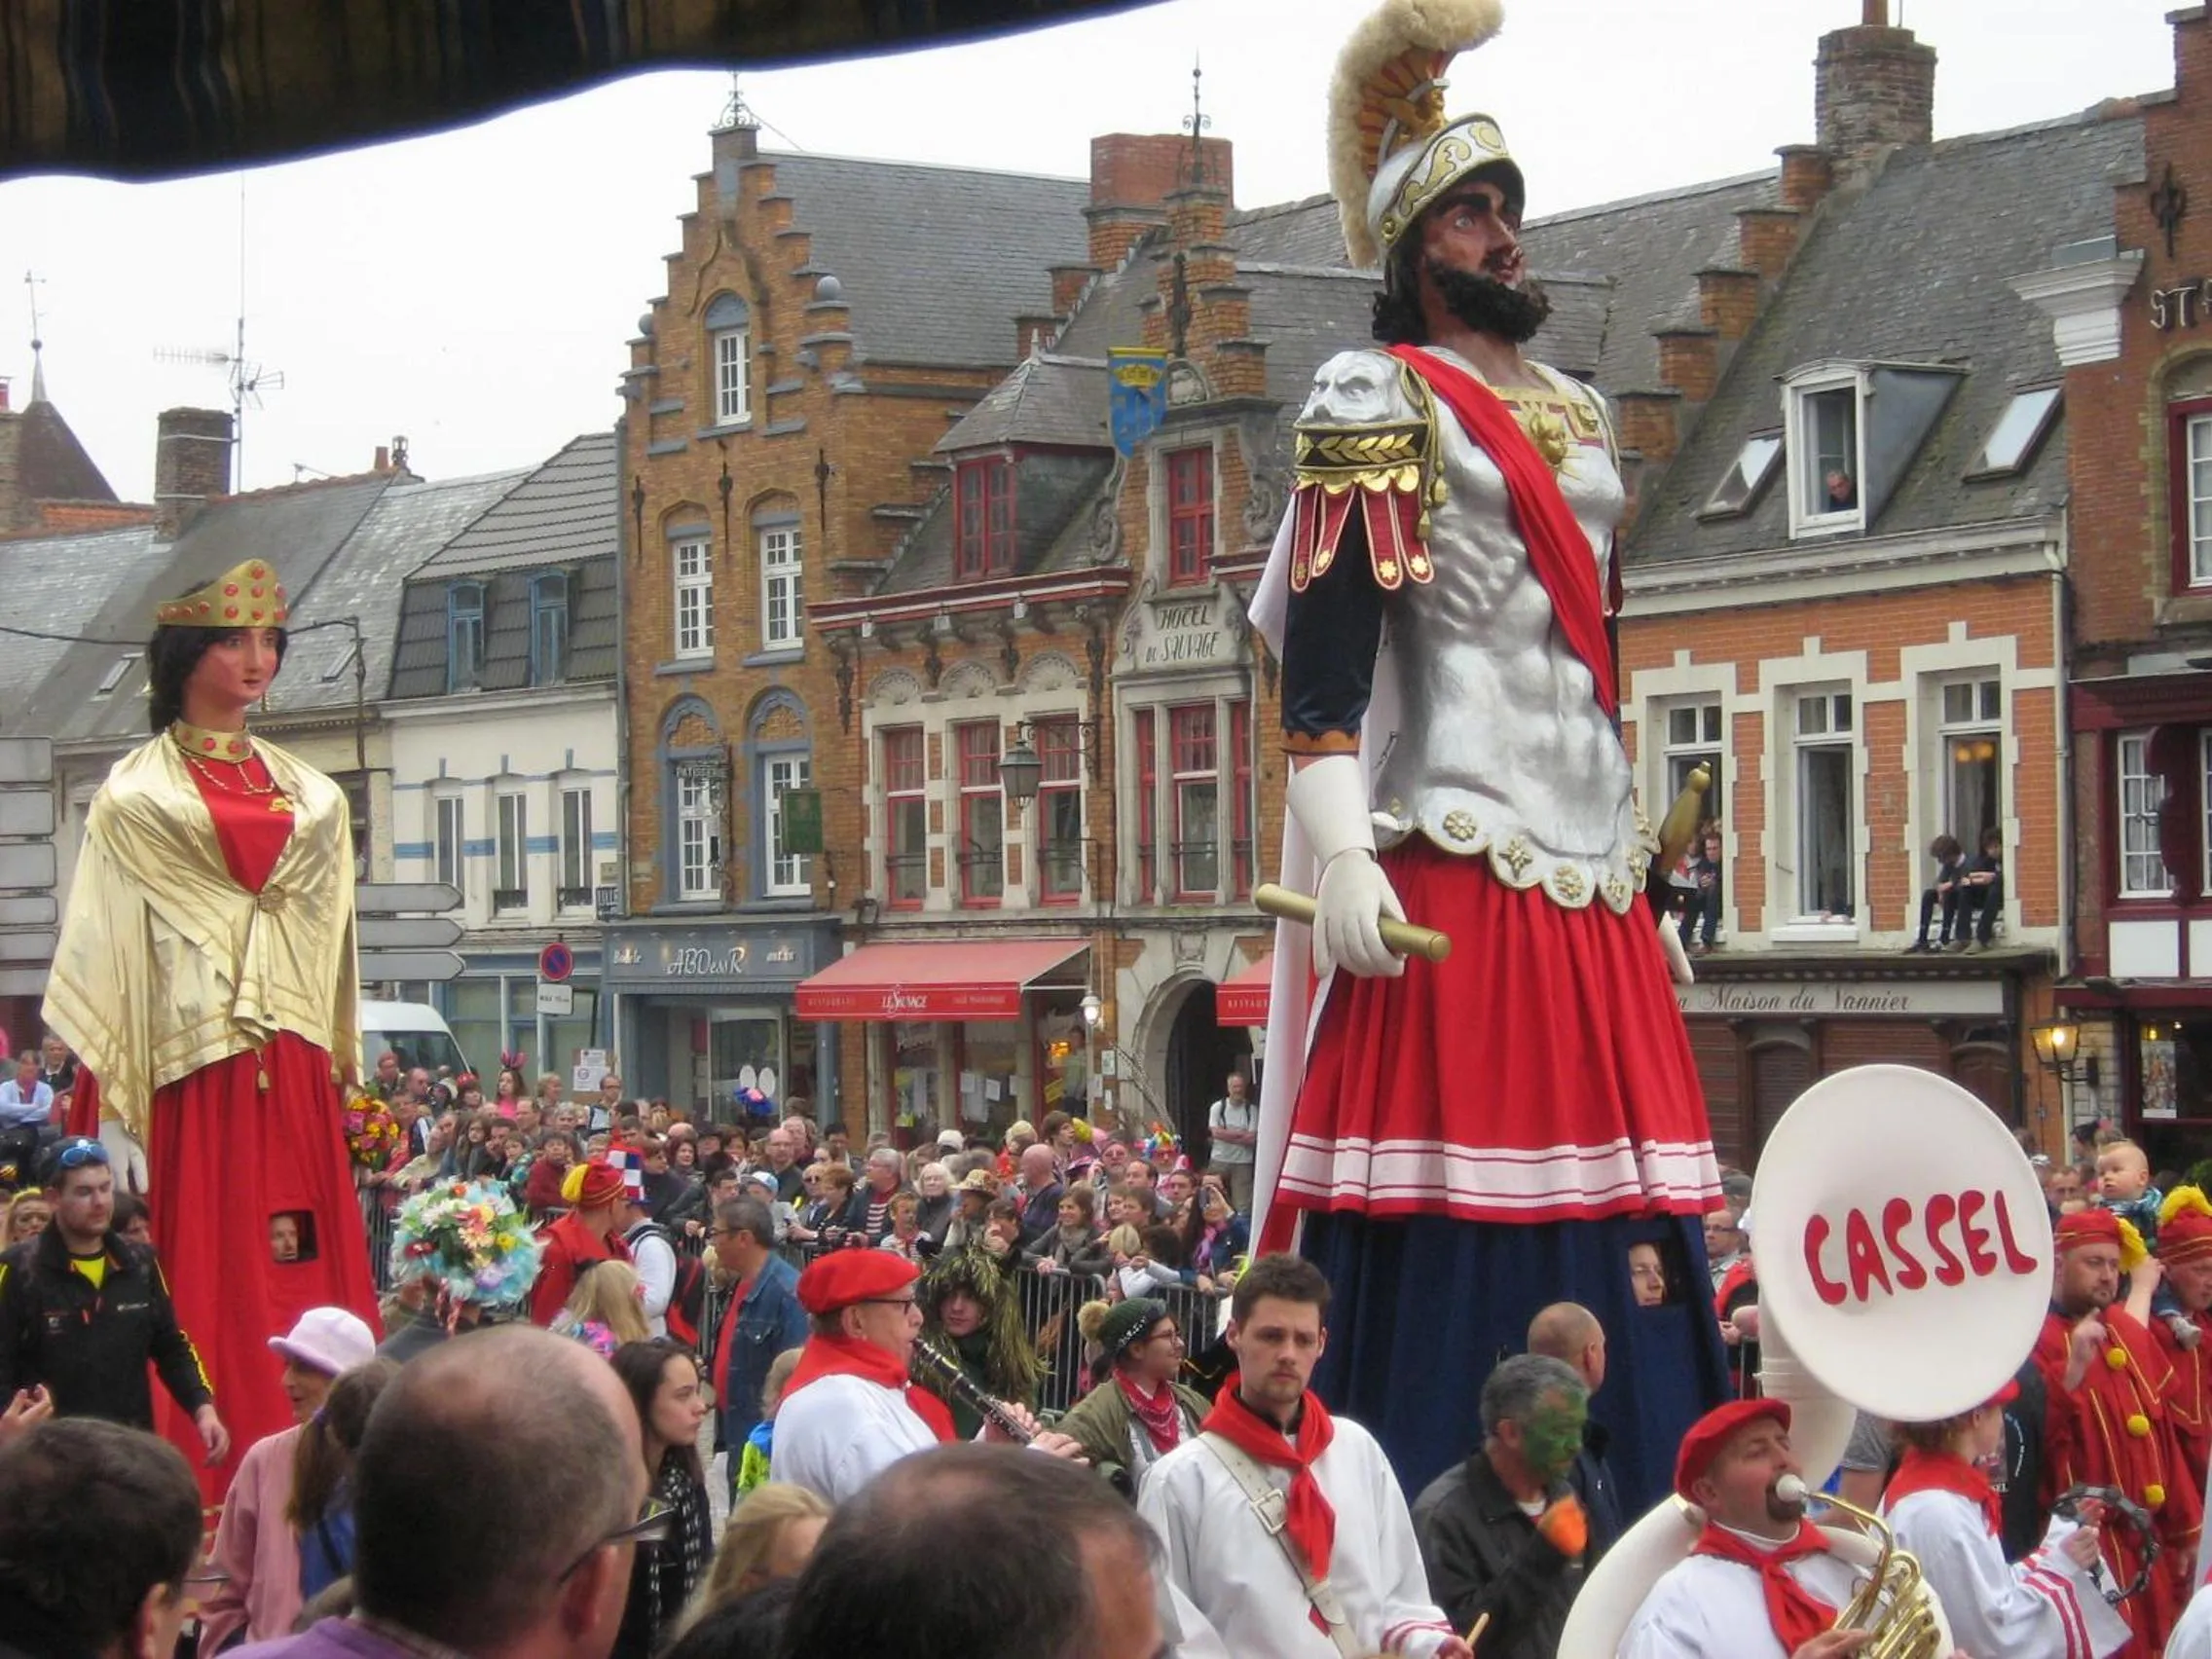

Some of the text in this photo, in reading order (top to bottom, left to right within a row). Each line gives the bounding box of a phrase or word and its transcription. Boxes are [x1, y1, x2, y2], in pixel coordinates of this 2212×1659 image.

[1159, 605, 1211, 630] HOTEL
[1161, 631, 1220, 661] SAUVAGE
[1700, 982, 1781, 1011] Maison
[1789, 984, 1814, 1010] du
[1804, 1190, 2038, 1305] CASSEL
